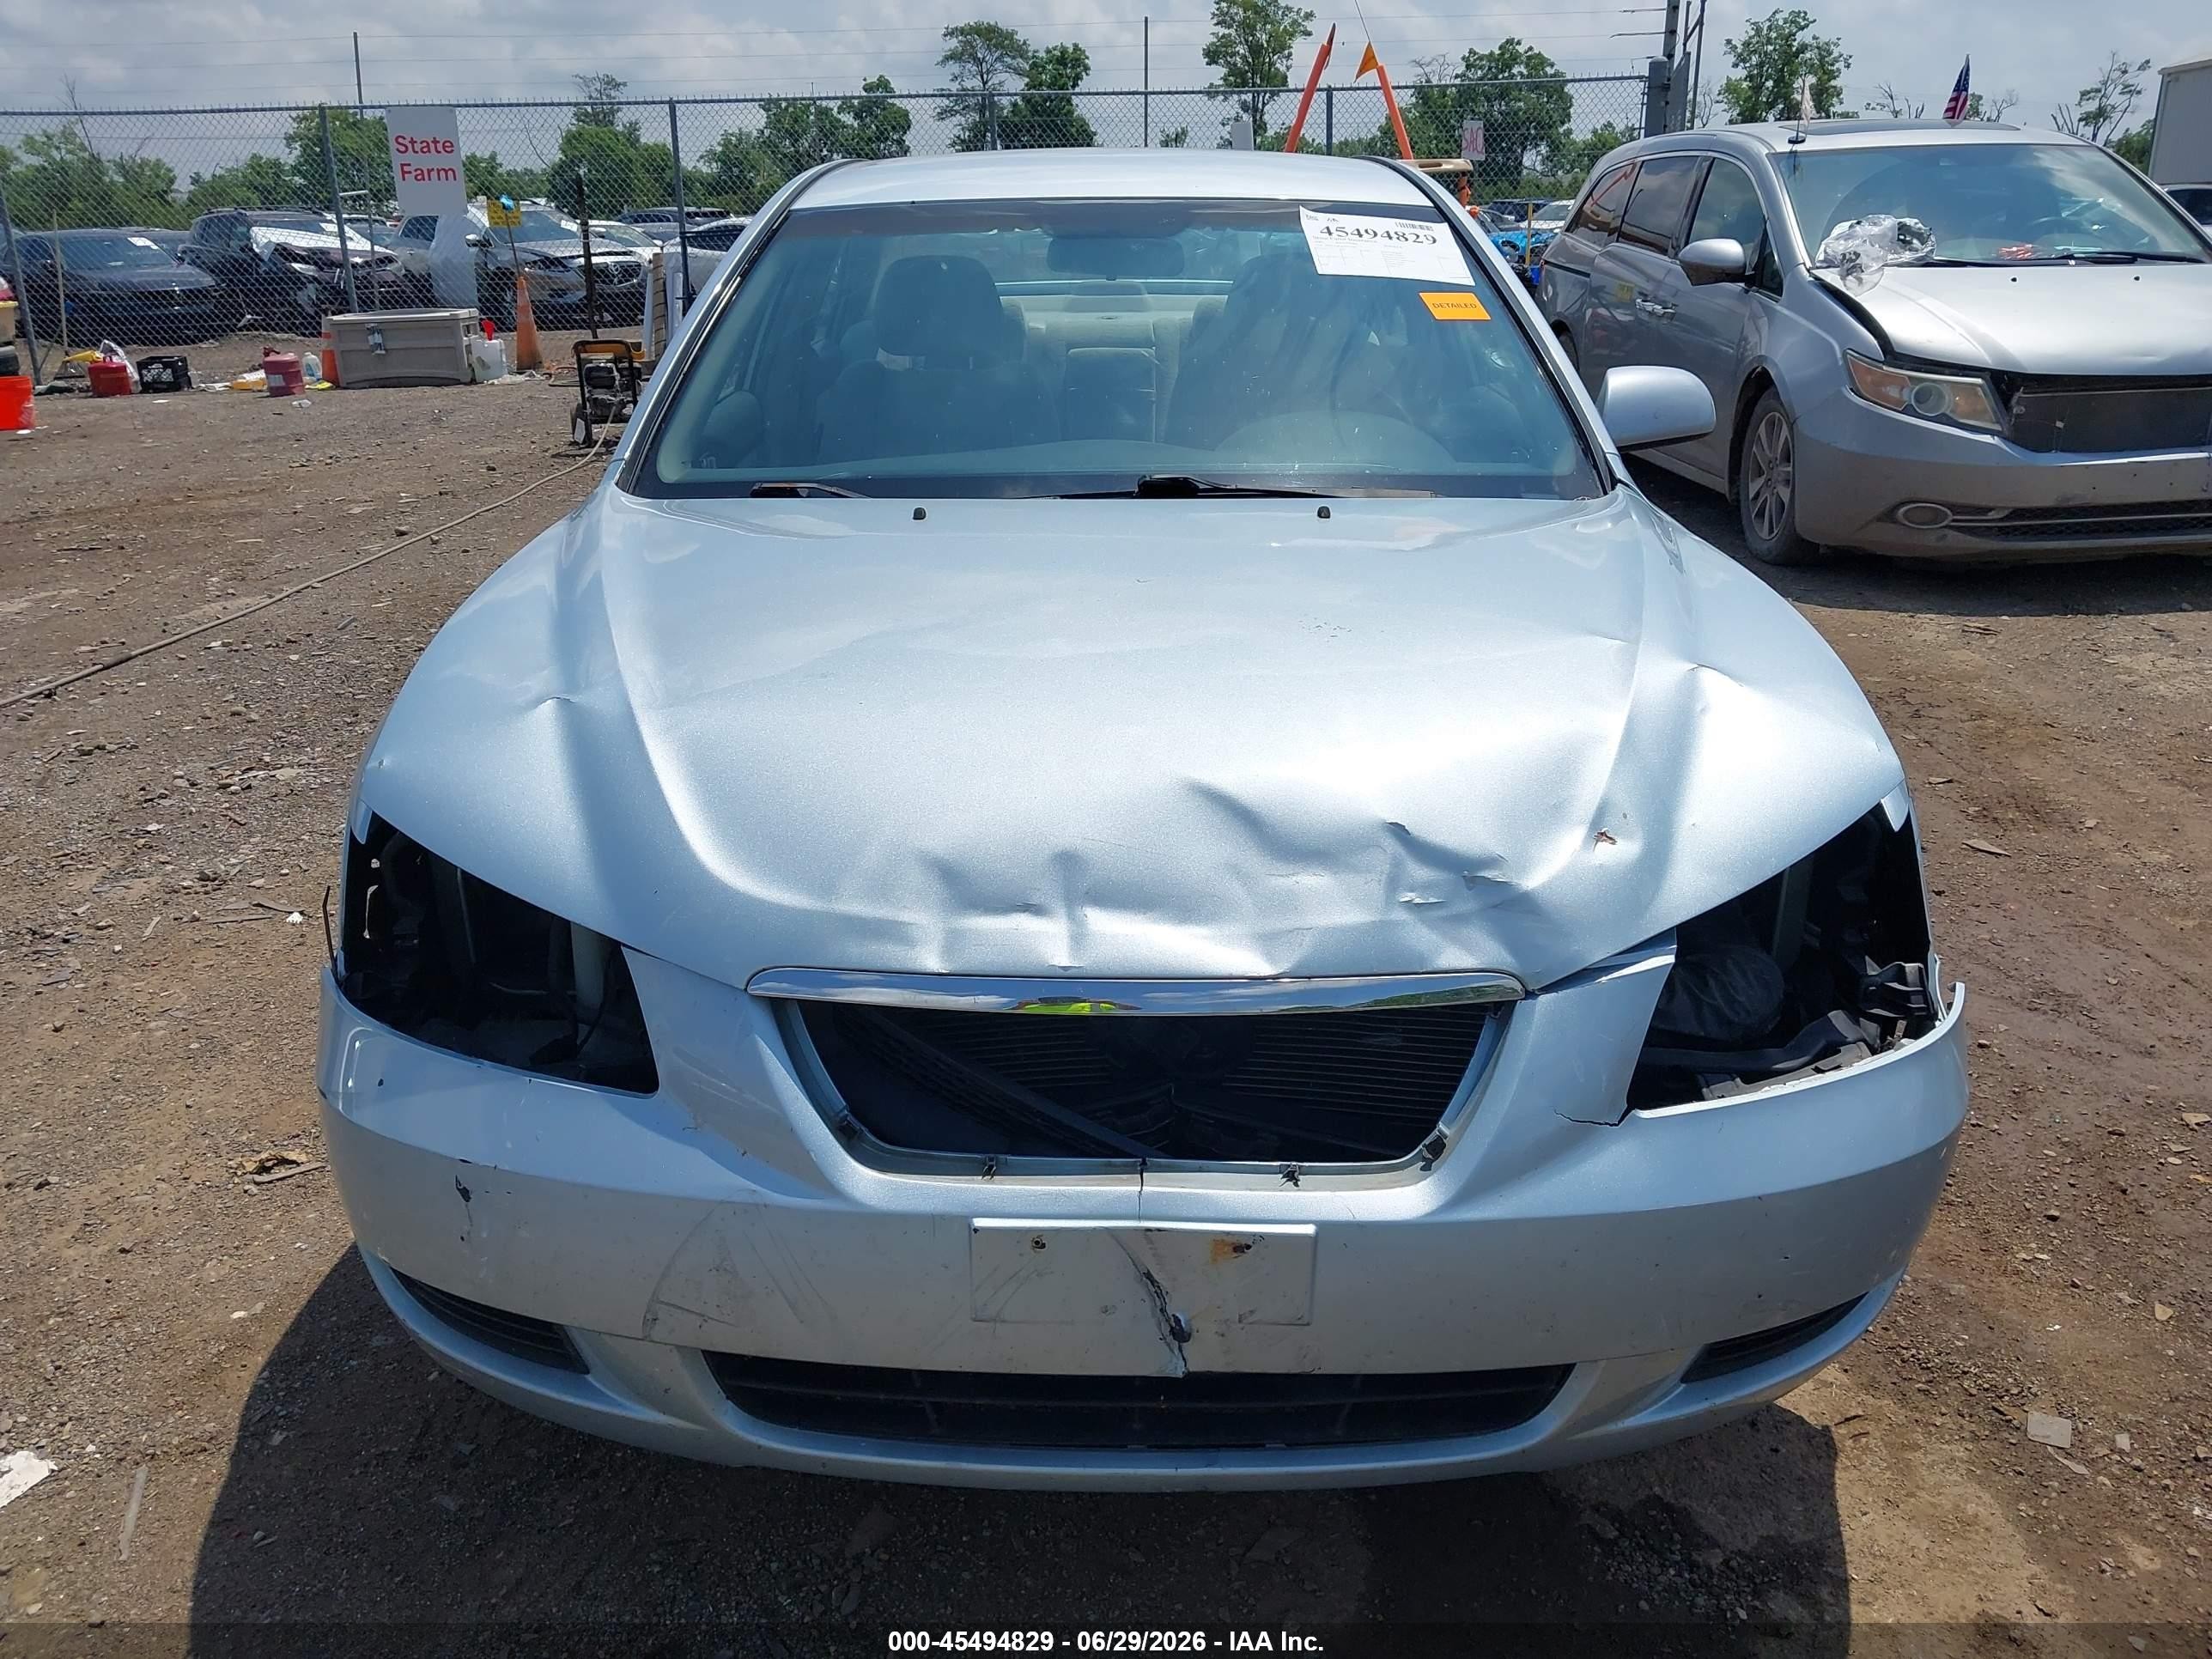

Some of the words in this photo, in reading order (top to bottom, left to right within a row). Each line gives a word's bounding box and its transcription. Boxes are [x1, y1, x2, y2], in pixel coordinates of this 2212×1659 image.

[394, 135, 455, 155] State
[399, 162, 457, 182] Farm
[1319, 224, 1438, 246] 45494829
